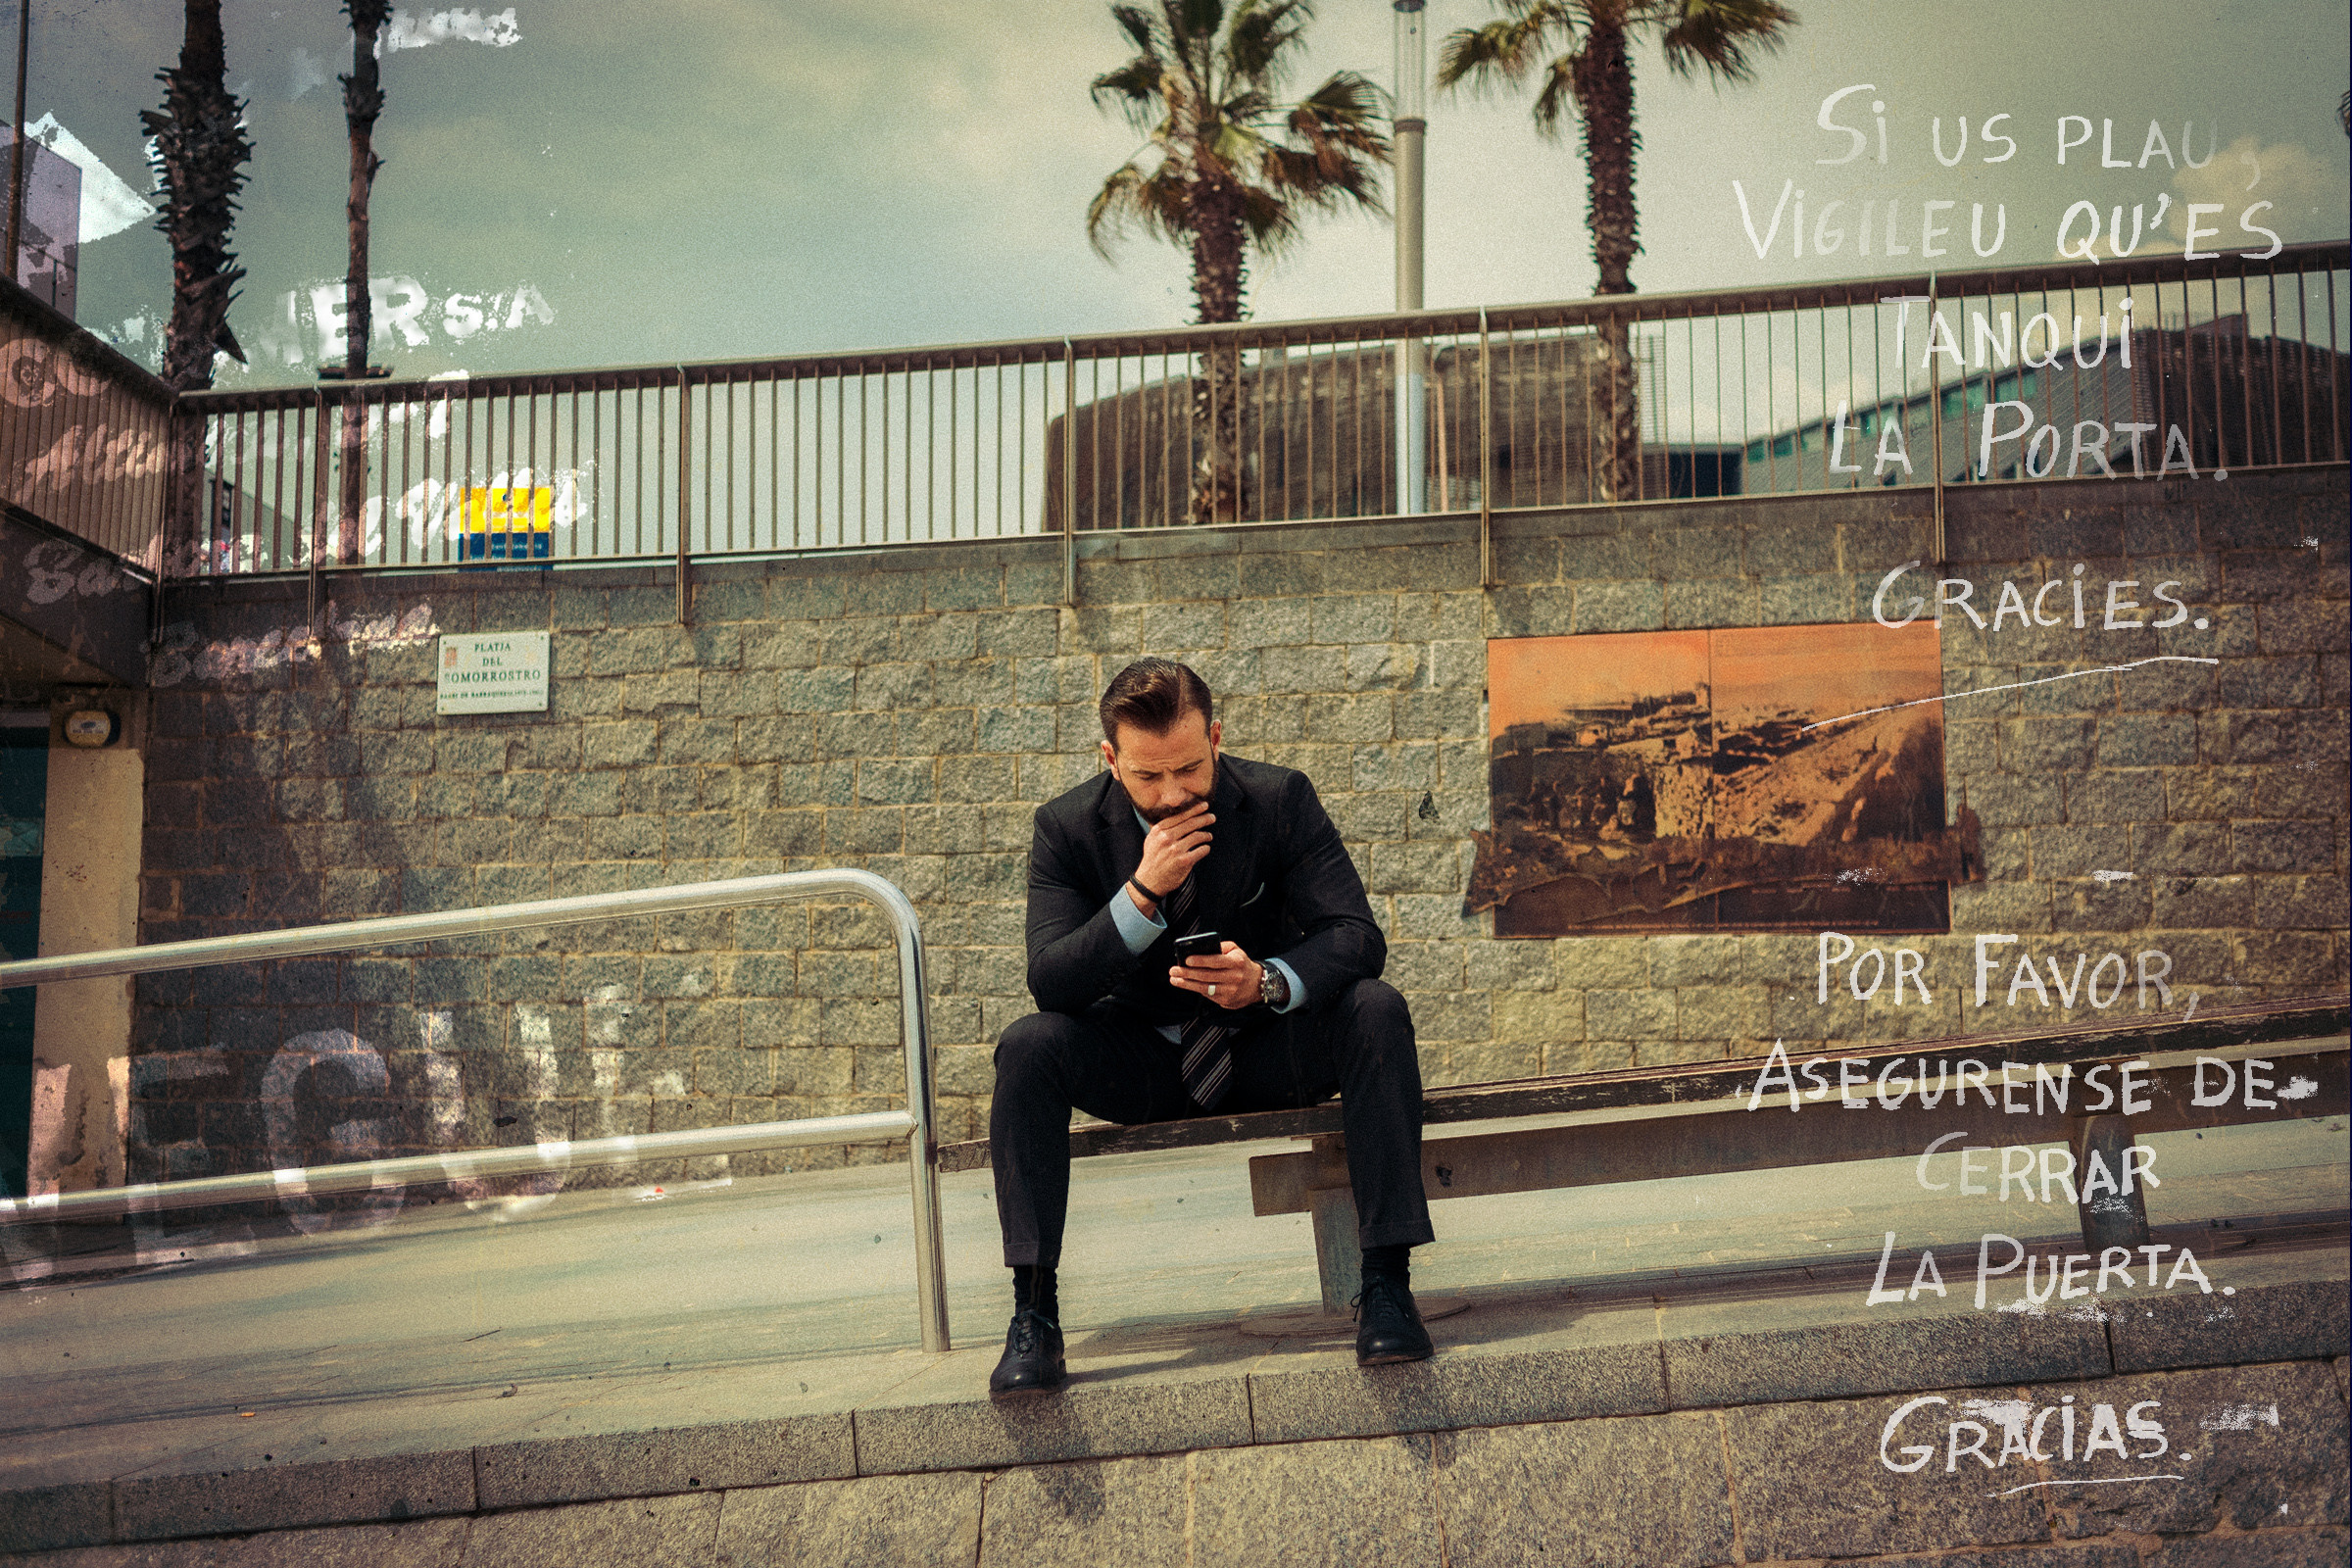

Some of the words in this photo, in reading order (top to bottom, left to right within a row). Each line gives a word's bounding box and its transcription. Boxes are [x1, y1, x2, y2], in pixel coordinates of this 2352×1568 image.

[474, 642, 511, 653] PLATJA
[482, 658, 503, 667] DEL
[444, 669, 541, 684] SOMORROSTRO
